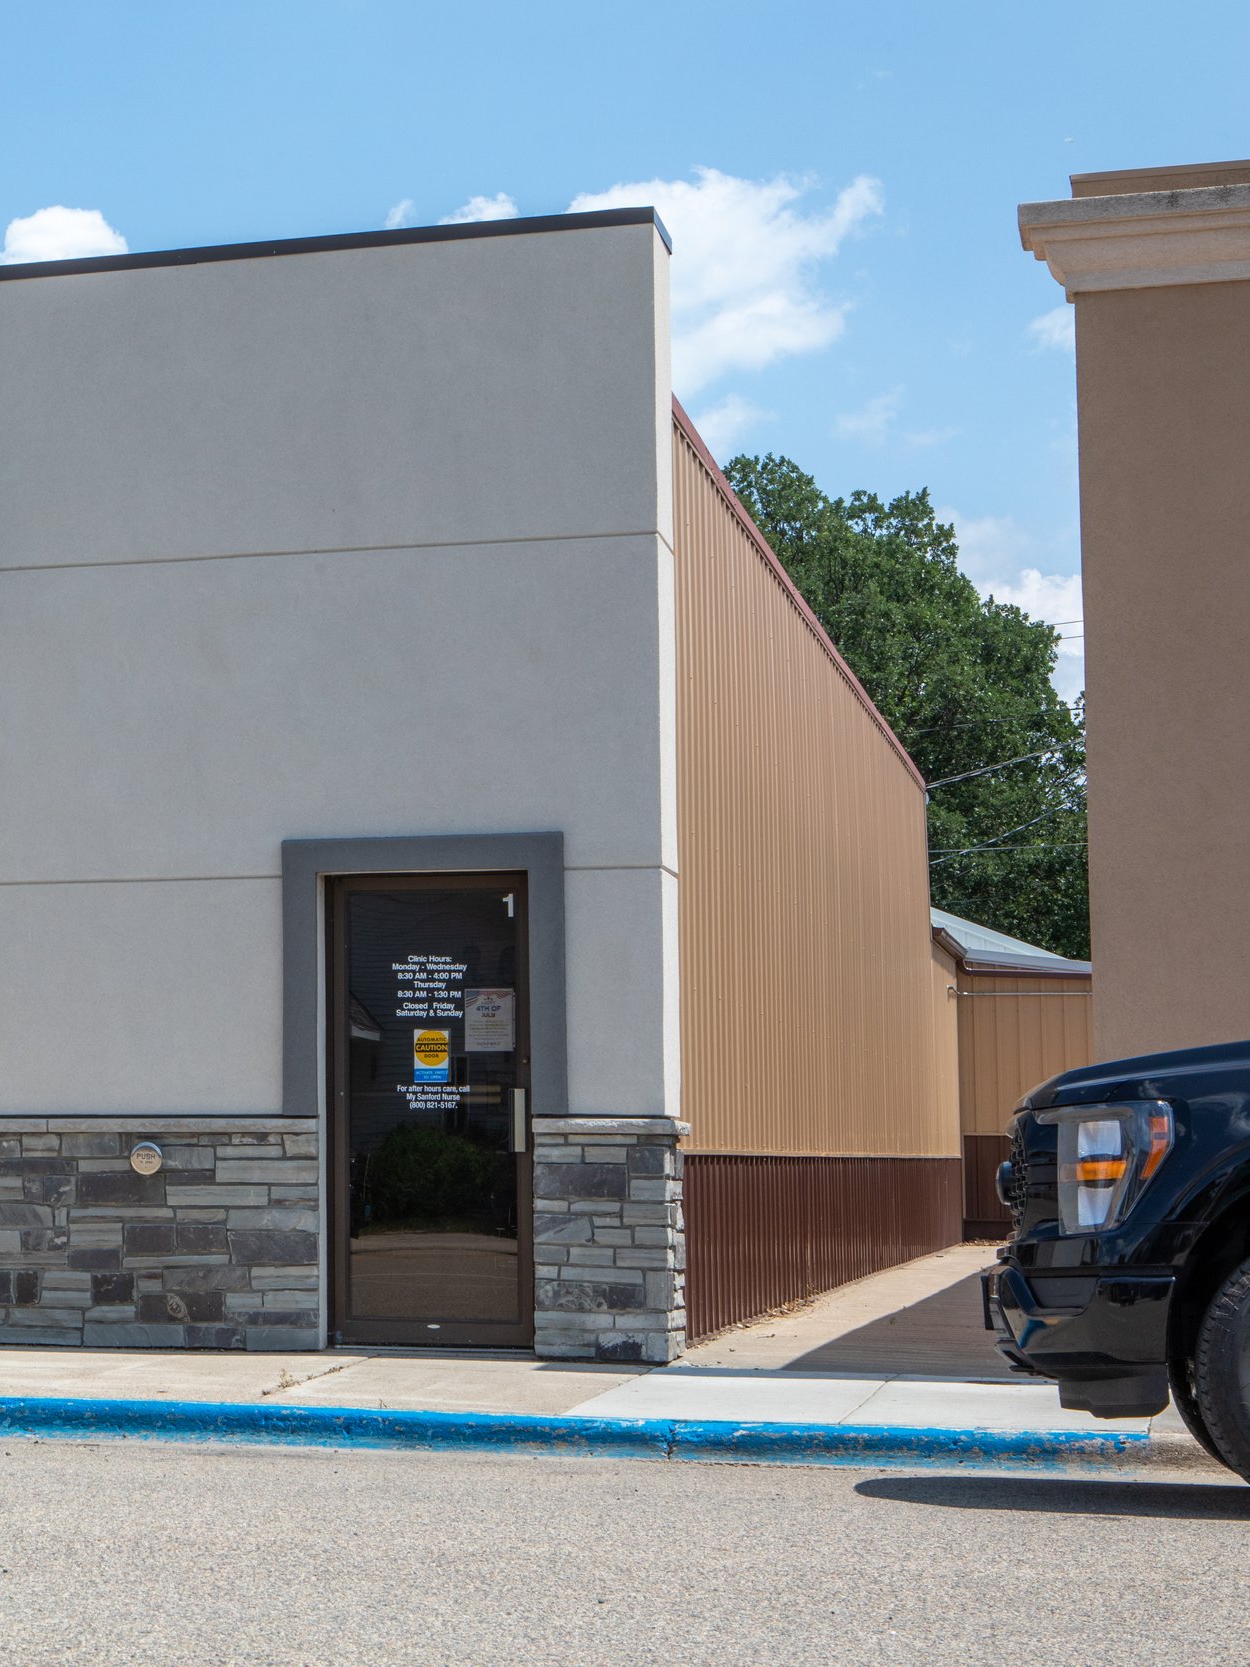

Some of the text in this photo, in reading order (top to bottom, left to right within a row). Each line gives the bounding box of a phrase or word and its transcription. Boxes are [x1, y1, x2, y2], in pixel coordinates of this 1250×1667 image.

[502, 893, 514, 917] 1
[392, 963, 420, 971] Monday
[426, 963, 467, 971] Wednesday
[413, 981, 446, 989] Thursday
[433, 1002, 455, 1010] Friday
[396, 1010, 428, 1018] Saturday
[437, 1010, 463, 1018] Sunday
[406, 1093, 416, 1101] My
